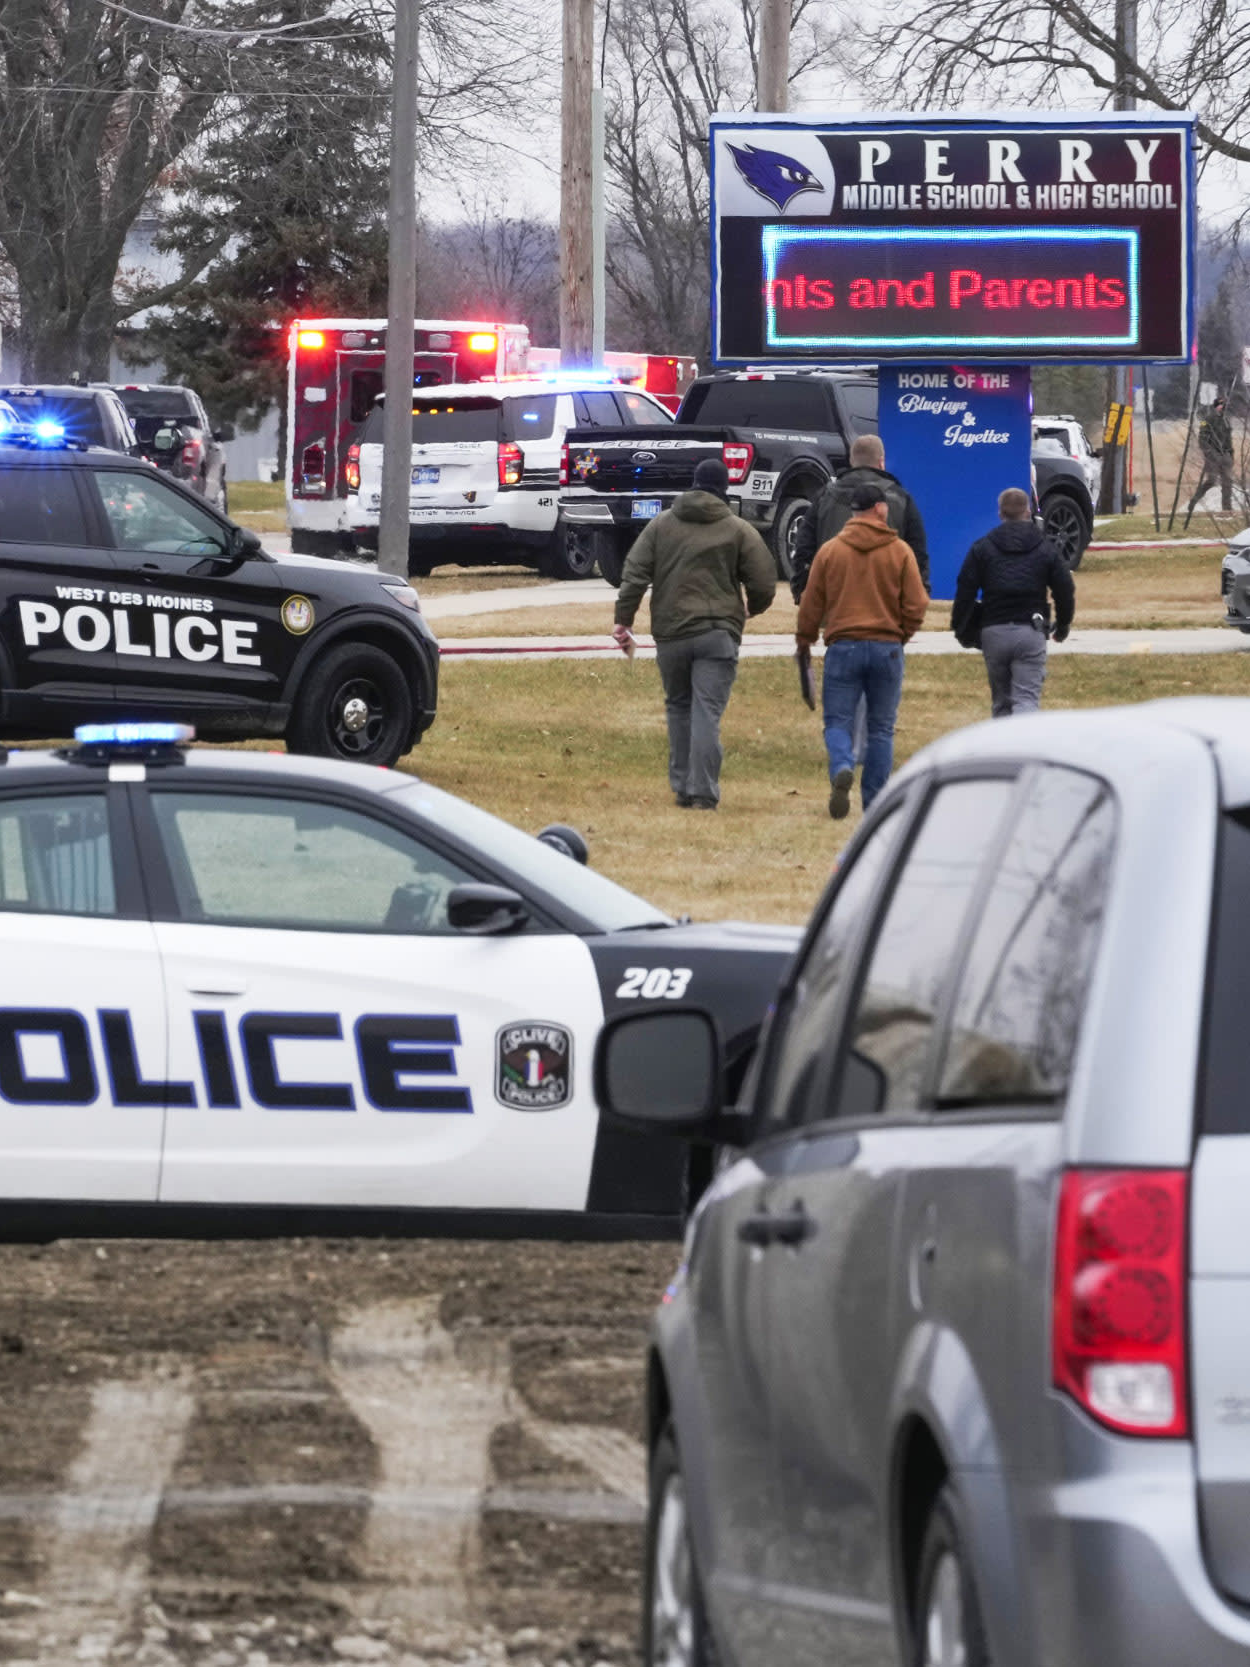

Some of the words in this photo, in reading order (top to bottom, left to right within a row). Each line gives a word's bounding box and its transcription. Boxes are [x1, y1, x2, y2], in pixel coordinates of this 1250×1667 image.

[858, 138, 1161, 183] PERRY
[842, 183, 922, 210] MIDDLE
[926, 183, 1011, 210] SCHOOL
[1015, 184, 1032, 209] &
[1035, 184, 1087, 210] HIGH
[1091, 183, 1178, 209] SCHOOL
[763, 274, 835, 310] nts
[849, 271, 936, 309] and
[949, 269, 1126, 309] Parents
[898, 373, 949, 389] HOME
[953, 373, 977, 389] OF
[980, 373, 1010, 389] THE
[897, 393, 968, 415] Bluejays
[962, 411, 976, 427] &
[601, 439, 688, 449] POLICE
[943, 424, 1010, 447] Jayettes
[752, 479, 773, 491] 911
[537, 497, 554, 507] 421
[55, 586, 106, 602] WEST
[109, 591, 143, 606] DES
[146, 594, 214, 613] MOINES
[18, 600, 262, 667] POLICE
[615, 967, 694, 1000] 203
[511, 1027, 559, 1049] CLIVE
